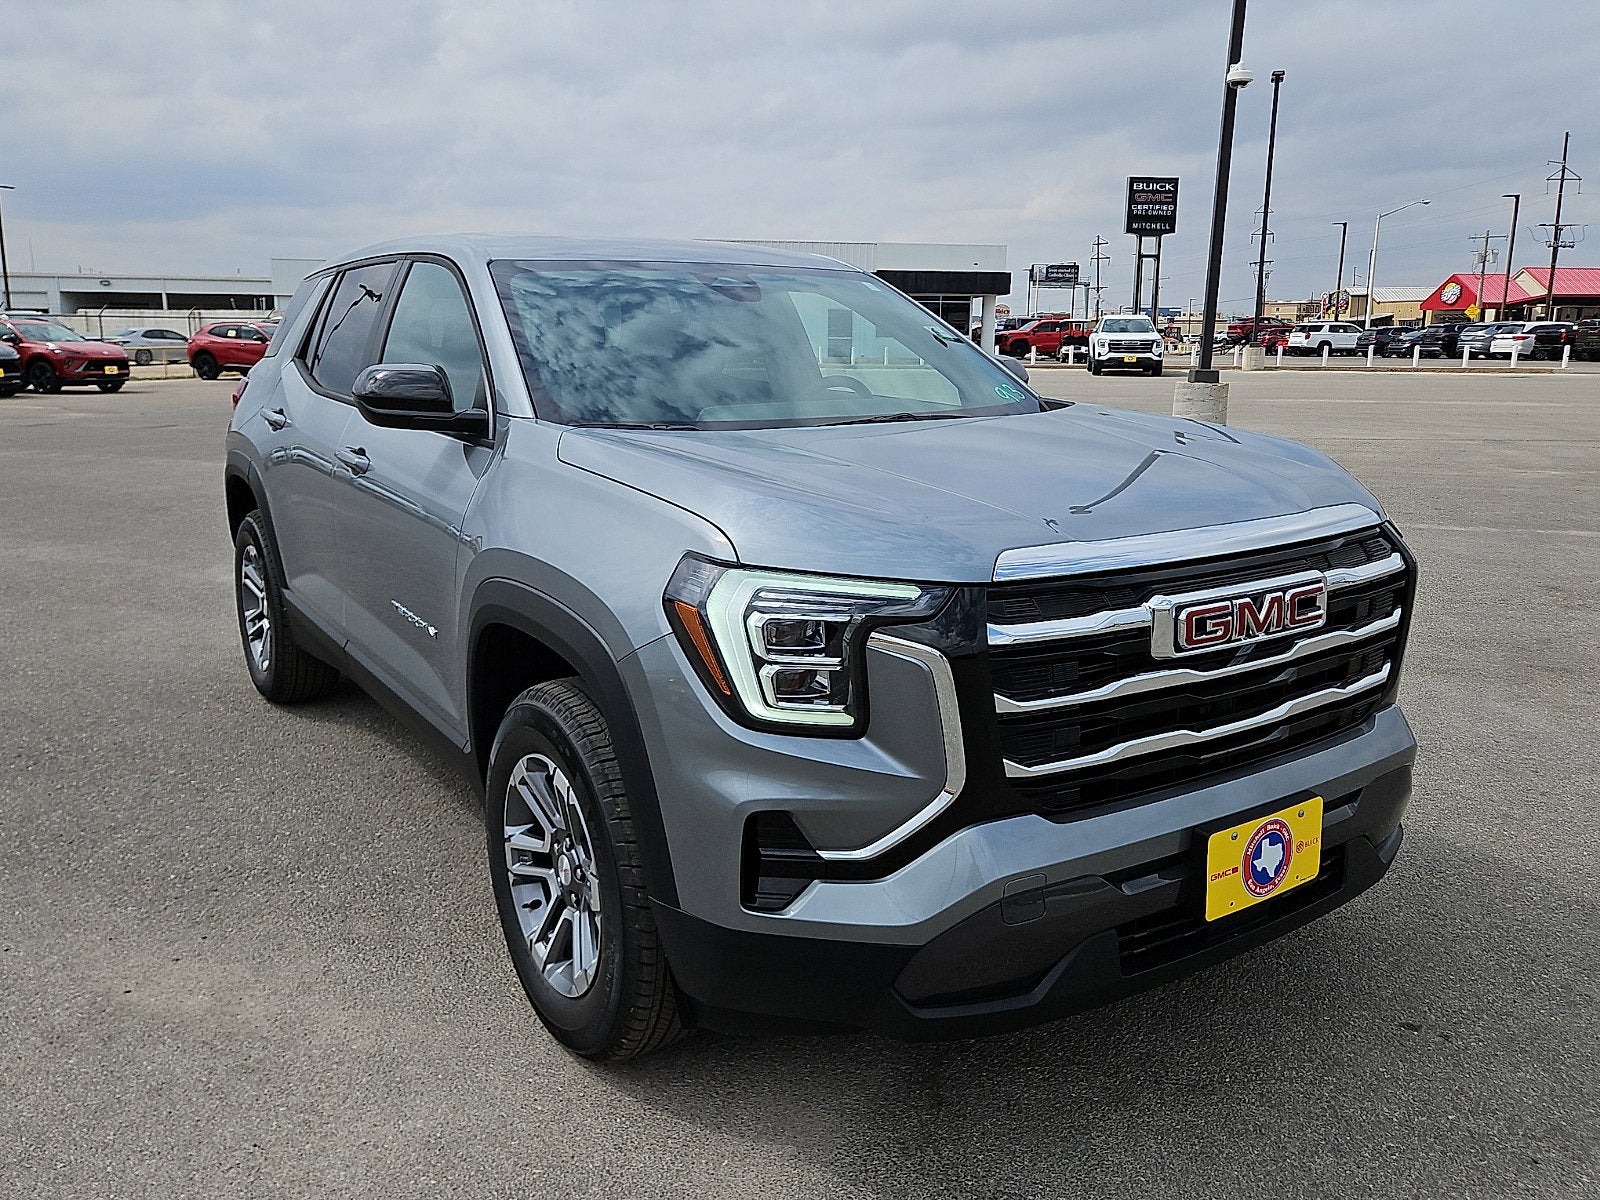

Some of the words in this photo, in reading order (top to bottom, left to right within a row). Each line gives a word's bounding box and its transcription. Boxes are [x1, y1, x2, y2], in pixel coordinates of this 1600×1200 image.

[1133, 182, 1175, 191] BUICK
[1135, 193, 1173, 202] GMC
[1178, 583, 1325, 648] GMC
[1246, 828, 1265, 856] Mitchell
[1282, 828, 1290, 842] GMC
[1304, 838, 1319, 848] BUICK
[1210, 869, 1232, 882] GMC
[1248, 878, 1256, 890] San
